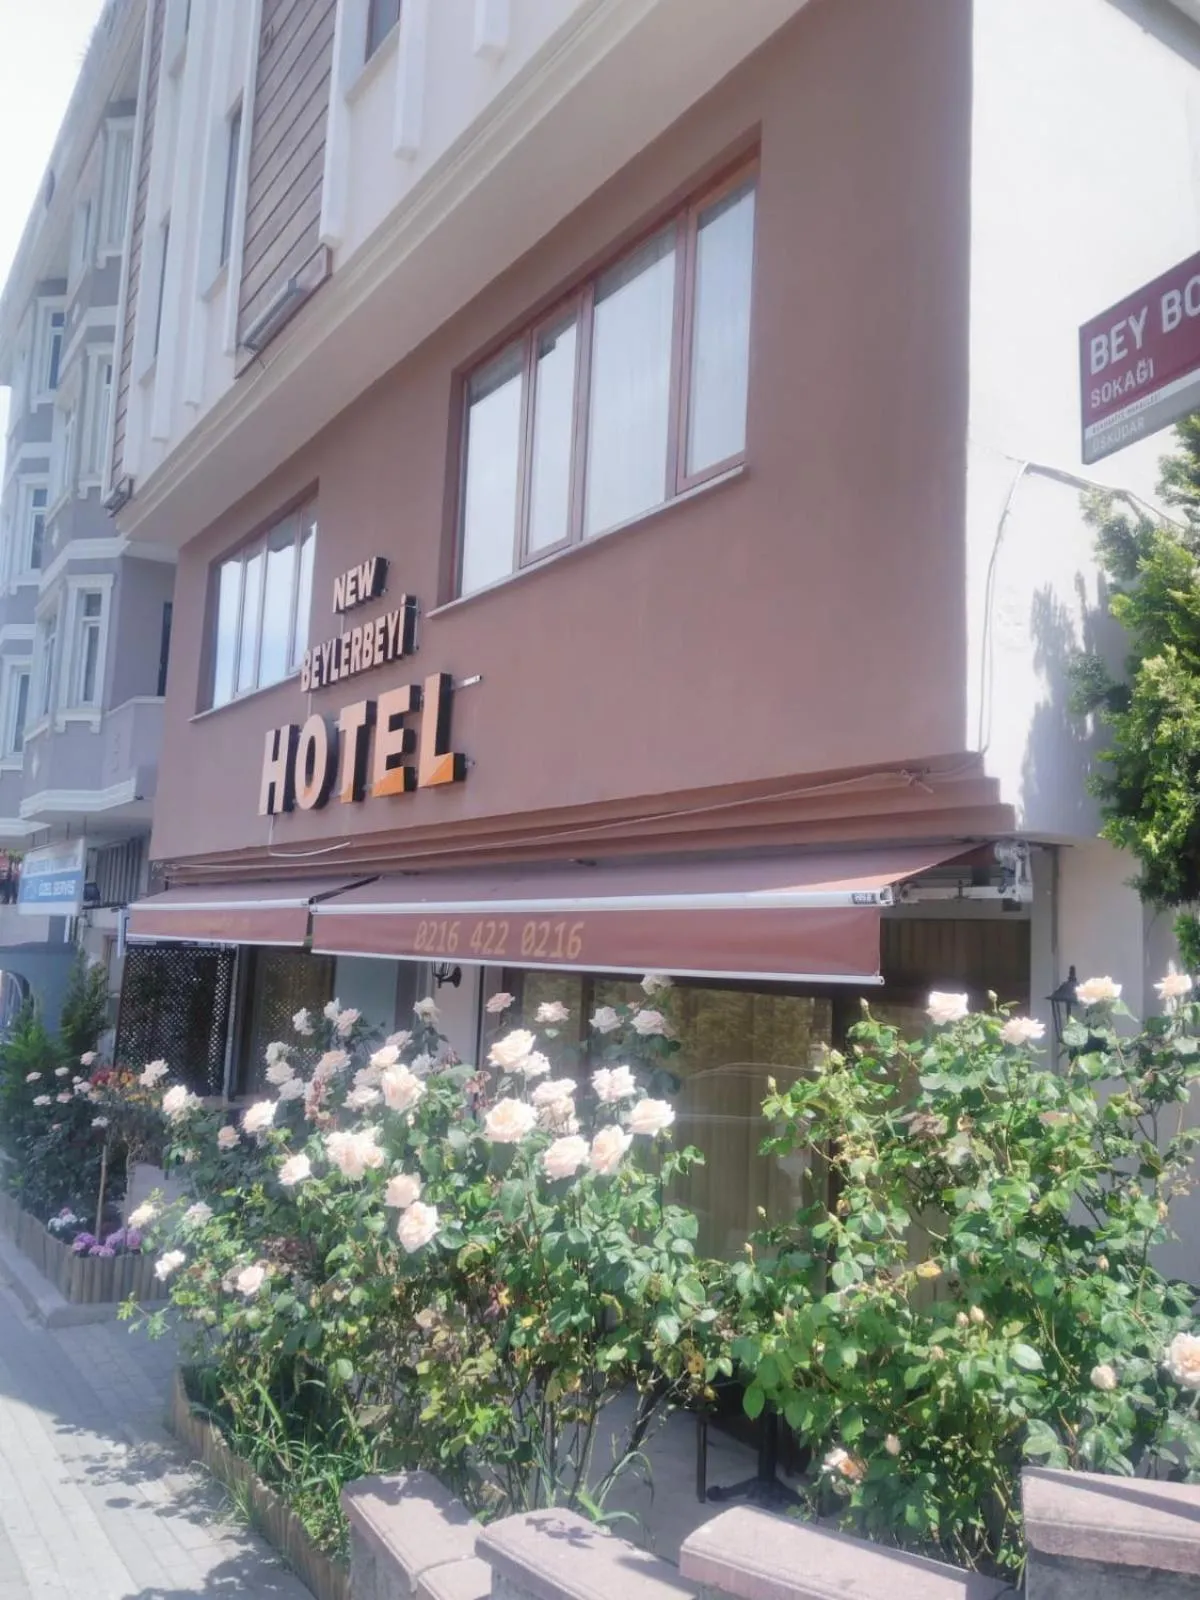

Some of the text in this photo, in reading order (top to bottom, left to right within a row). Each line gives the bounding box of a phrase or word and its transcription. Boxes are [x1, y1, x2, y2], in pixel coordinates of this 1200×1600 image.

[1090, 305, 1148, 376] BEY
[1091, 357, 1154, 408] SOKAĞI
[333, 557, 378, 613] NEW
[301, 593, 410, 692] BEYLERBEYİ
[258, 673, 458, 815] HOTEL
[414, 921, 585, 959] 0216 422 0216
